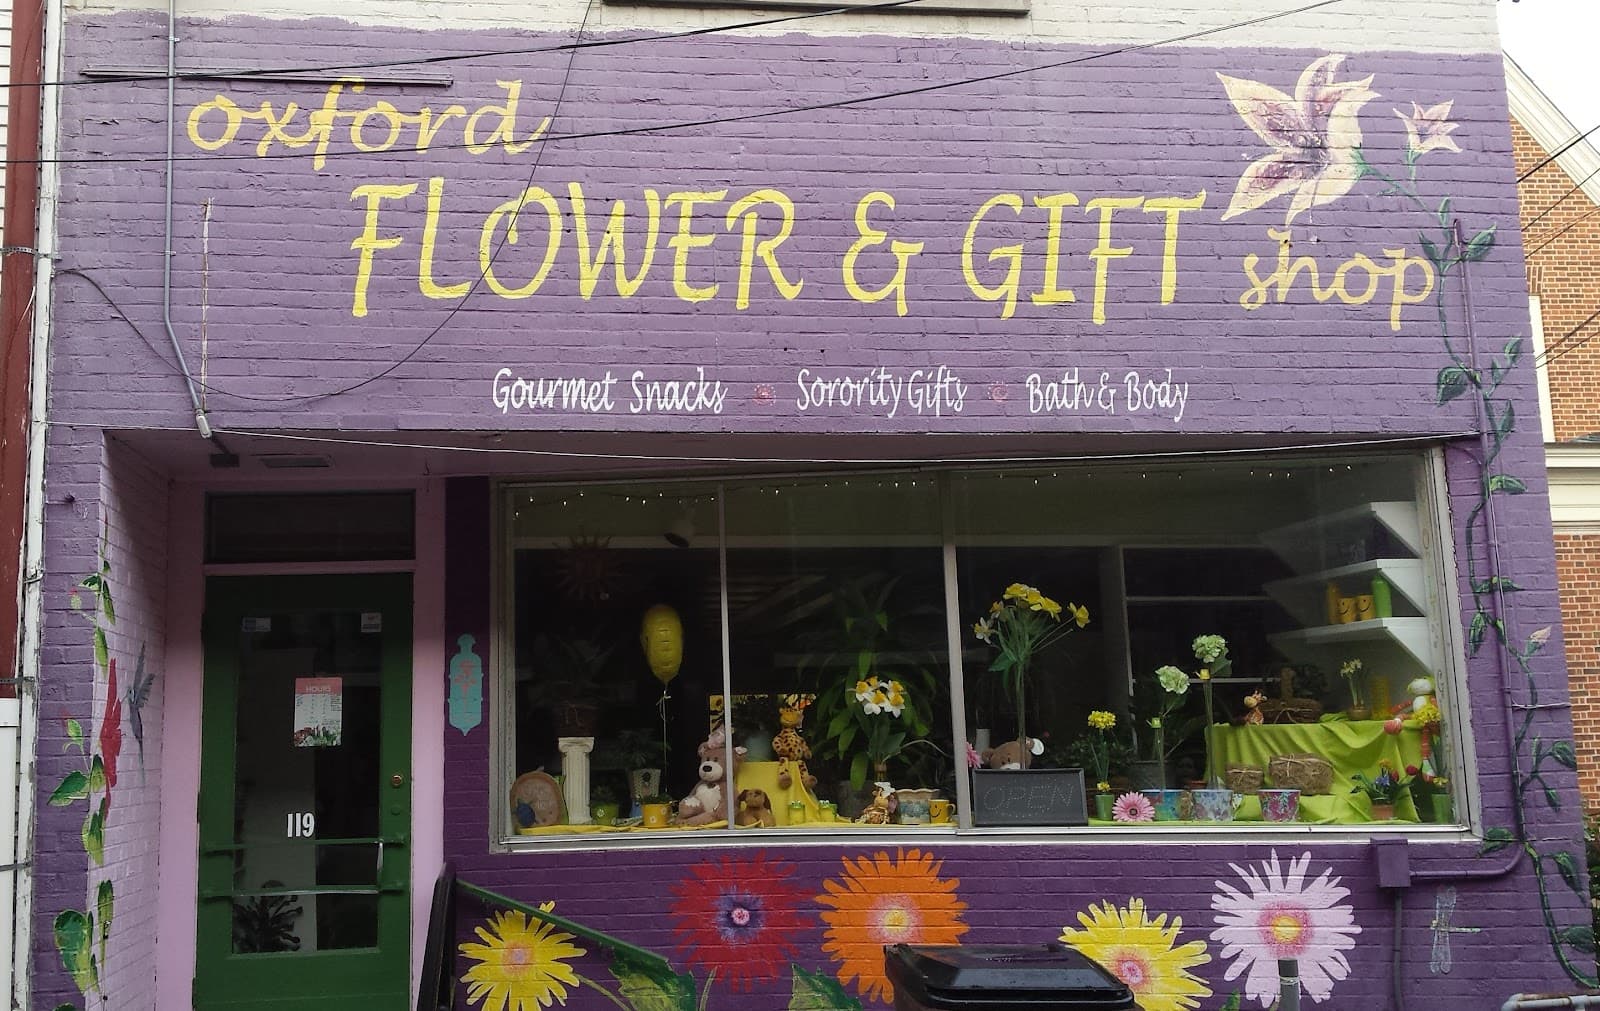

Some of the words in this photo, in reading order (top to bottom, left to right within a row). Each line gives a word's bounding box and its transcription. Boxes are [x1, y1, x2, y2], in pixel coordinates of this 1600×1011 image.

[186, 75, 552, 171] oxford
[350, 176, 804, 318] FLOWER
[842, 190, 924, 317] &
[961, 188, 1207, 325] GIFT
[1239, 227, 1435, 331] shop
[492, 367, 618, 414] Gourmet
[629, 366, 728, 414] Snacks
[796, 366, 903, 418] Sorority
[907, 364, 968, 418] Gifts
[1026, 367, 1094, 413] Bath
[1124, 368, 1189, 422] Body
[287, 812, 315, 838] 119
[983, 784, 1074, 810] OPEN
